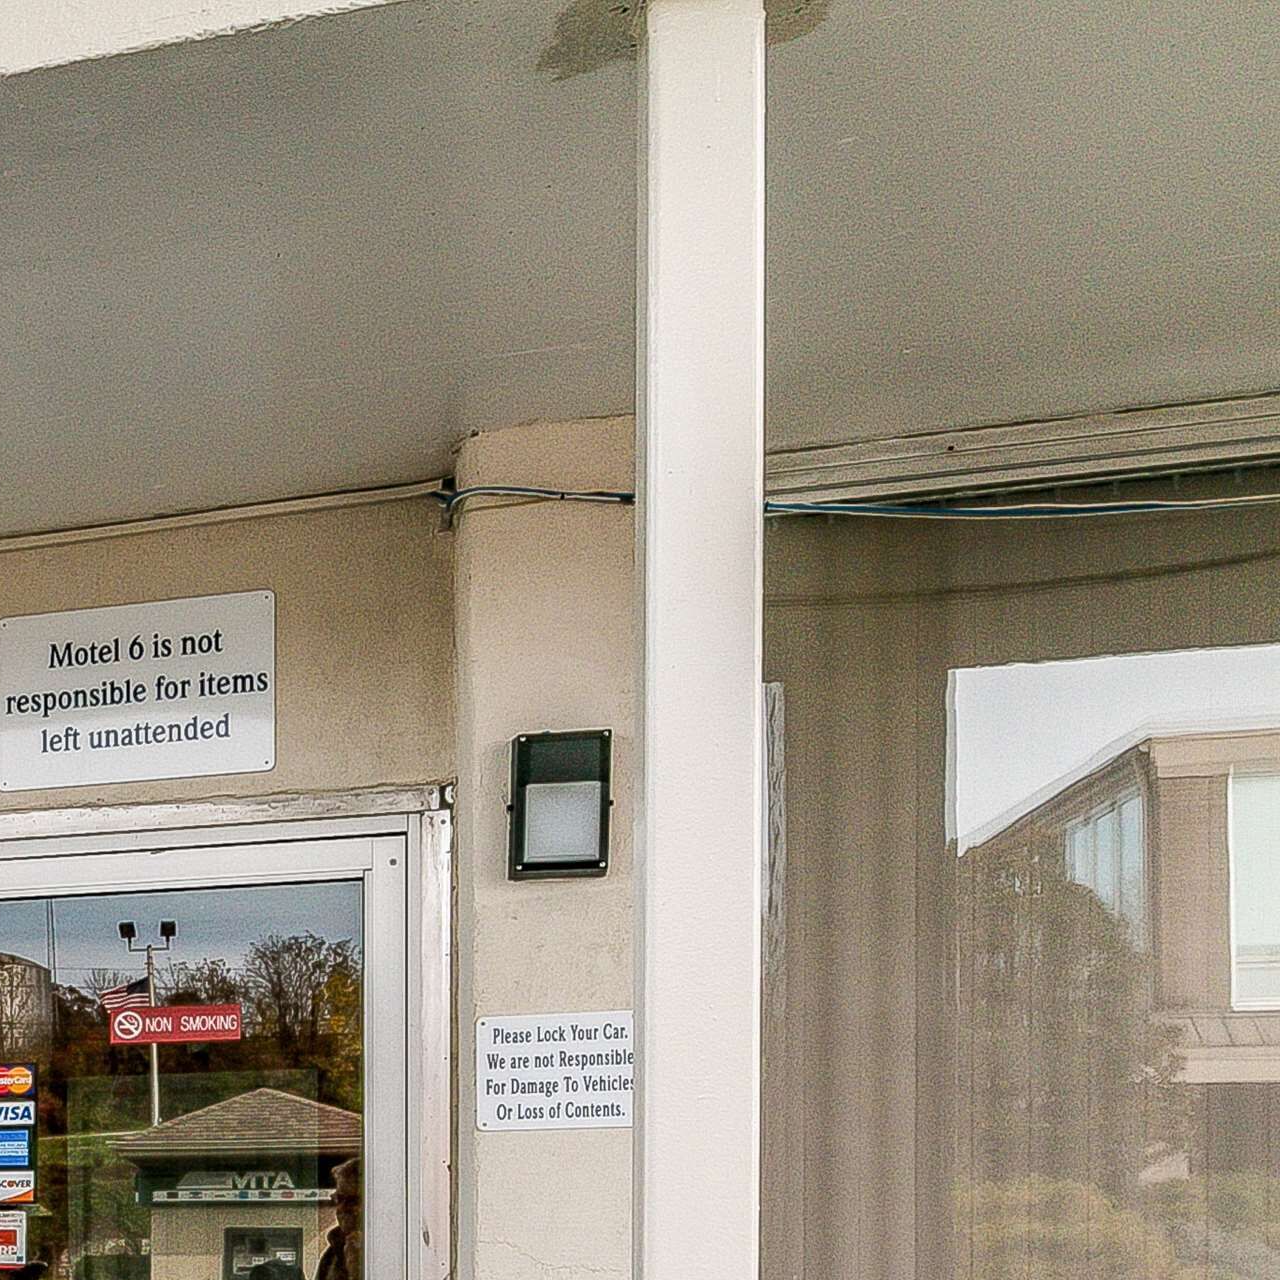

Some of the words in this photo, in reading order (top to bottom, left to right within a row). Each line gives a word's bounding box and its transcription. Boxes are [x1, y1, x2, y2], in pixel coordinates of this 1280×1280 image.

[48, 638, 120, 669] Motel
[128, 634, 144, 661] 6
[152, 633, 172, 659] is
[180, 629, 223, 656] not
[5, 680, 147, 717] responsible
[155, 675, 191, 701] for
[198, 671, 269, 697] items
[41, 726, 81, 753] left
[88, 713, 231, 750] unattended
[145, 1016, 172, 1032] NON
[180, 1015, 237, 1032] SMOKING
[493, 1028, 532, 1044] Please
[537, 1025, 566, 1042] Lock
[570, 1024, 599, 1041] Your
[603, 1023, 628, 1040] Car.
[487, 1053, 506, 1070] We
[510, 1056, 530, 1069] are
[534, 1053, 555, 1068] not
[559, 1049, 634, 1071] Responsible
[486, 1079, 506, 1095] For
[511, 1078, 559, 1098] Damage
[563, 1076, 578, 1093] To
[496, 1104, 513, 1120] Or
[518, 1104, 544, 1119] Loss
[548, 1102, 562, 1118] of
[565, 1101, 625, 1119] Contents.
